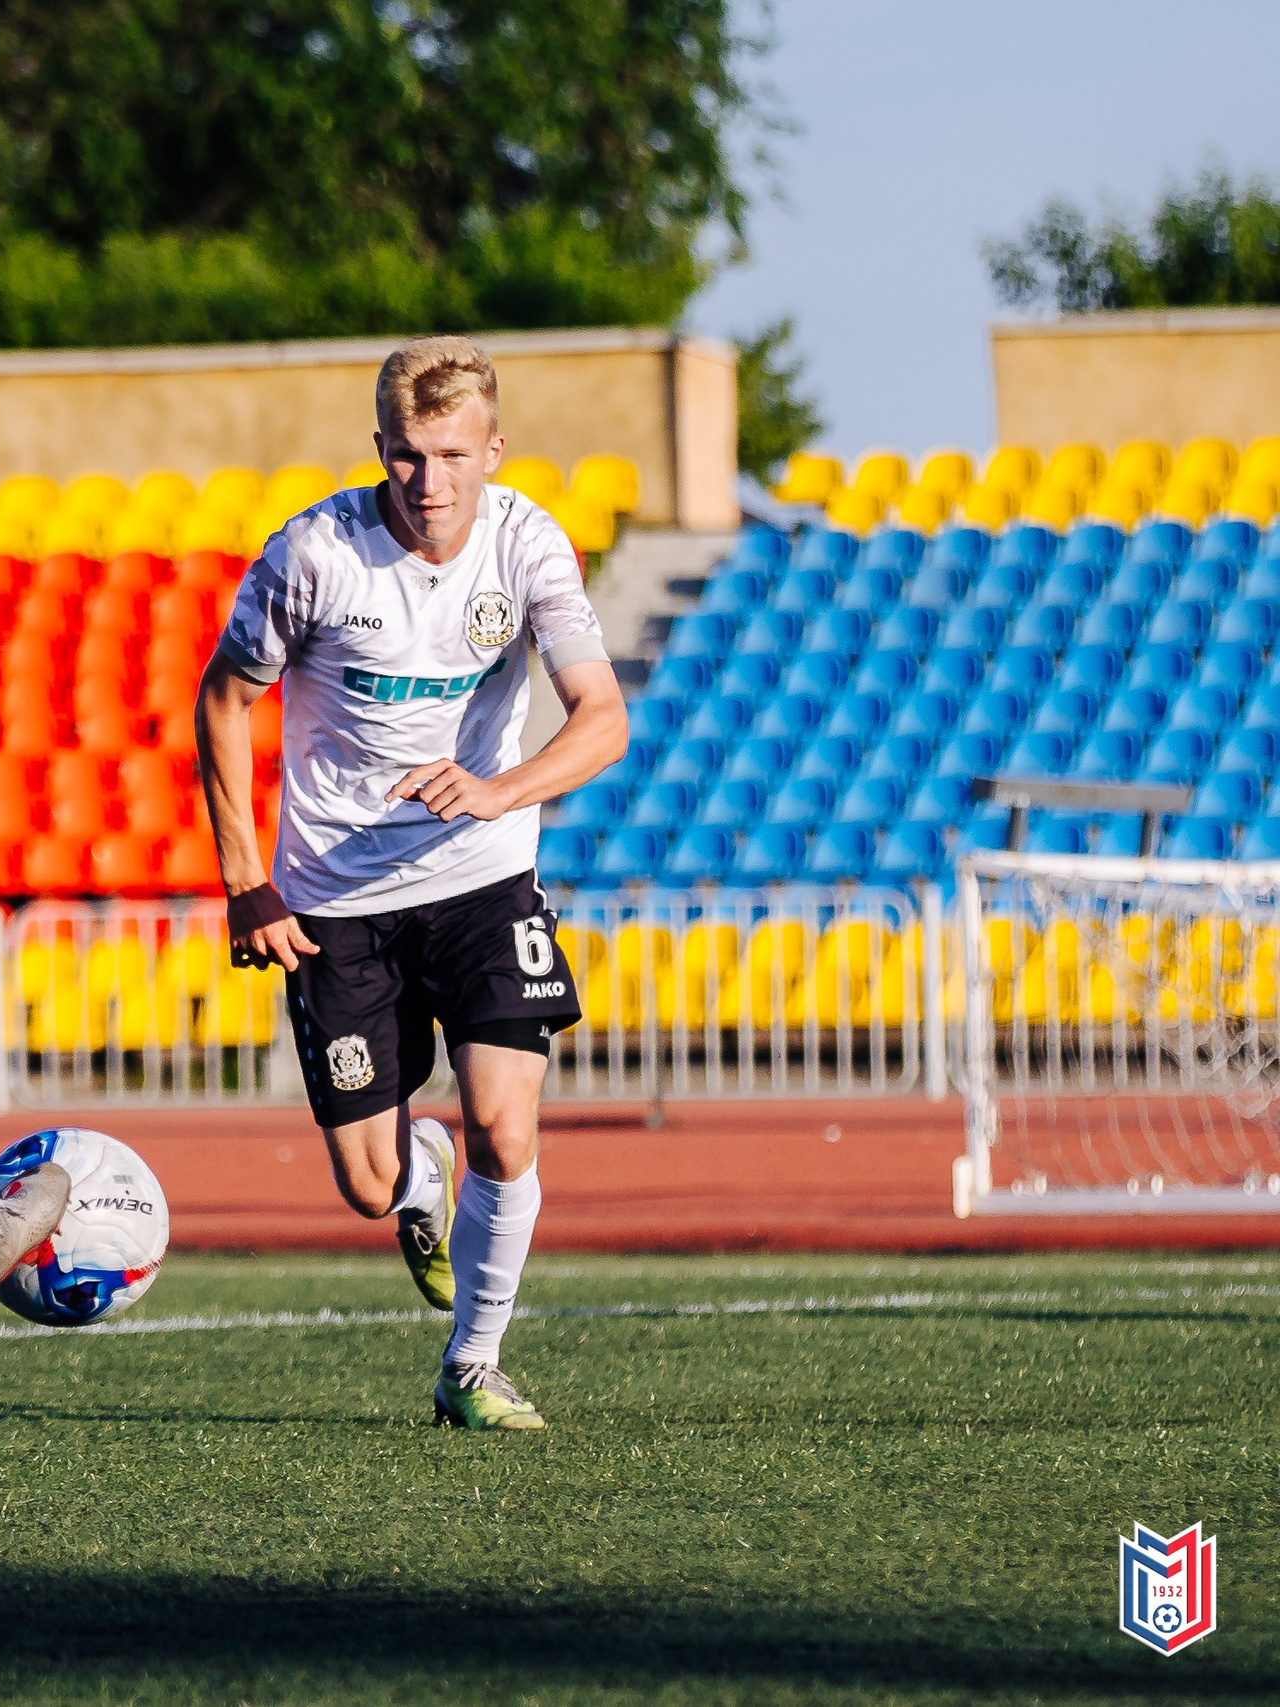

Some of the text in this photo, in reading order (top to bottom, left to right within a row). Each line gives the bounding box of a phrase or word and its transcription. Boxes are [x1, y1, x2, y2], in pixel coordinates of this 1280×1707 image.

[341, 614, 383, 631] JAKO
[512, 915, 554, 977] 6
[522, 981, 567, 999] JAKO
[73, 1198, 154, 1216] DEMIX
